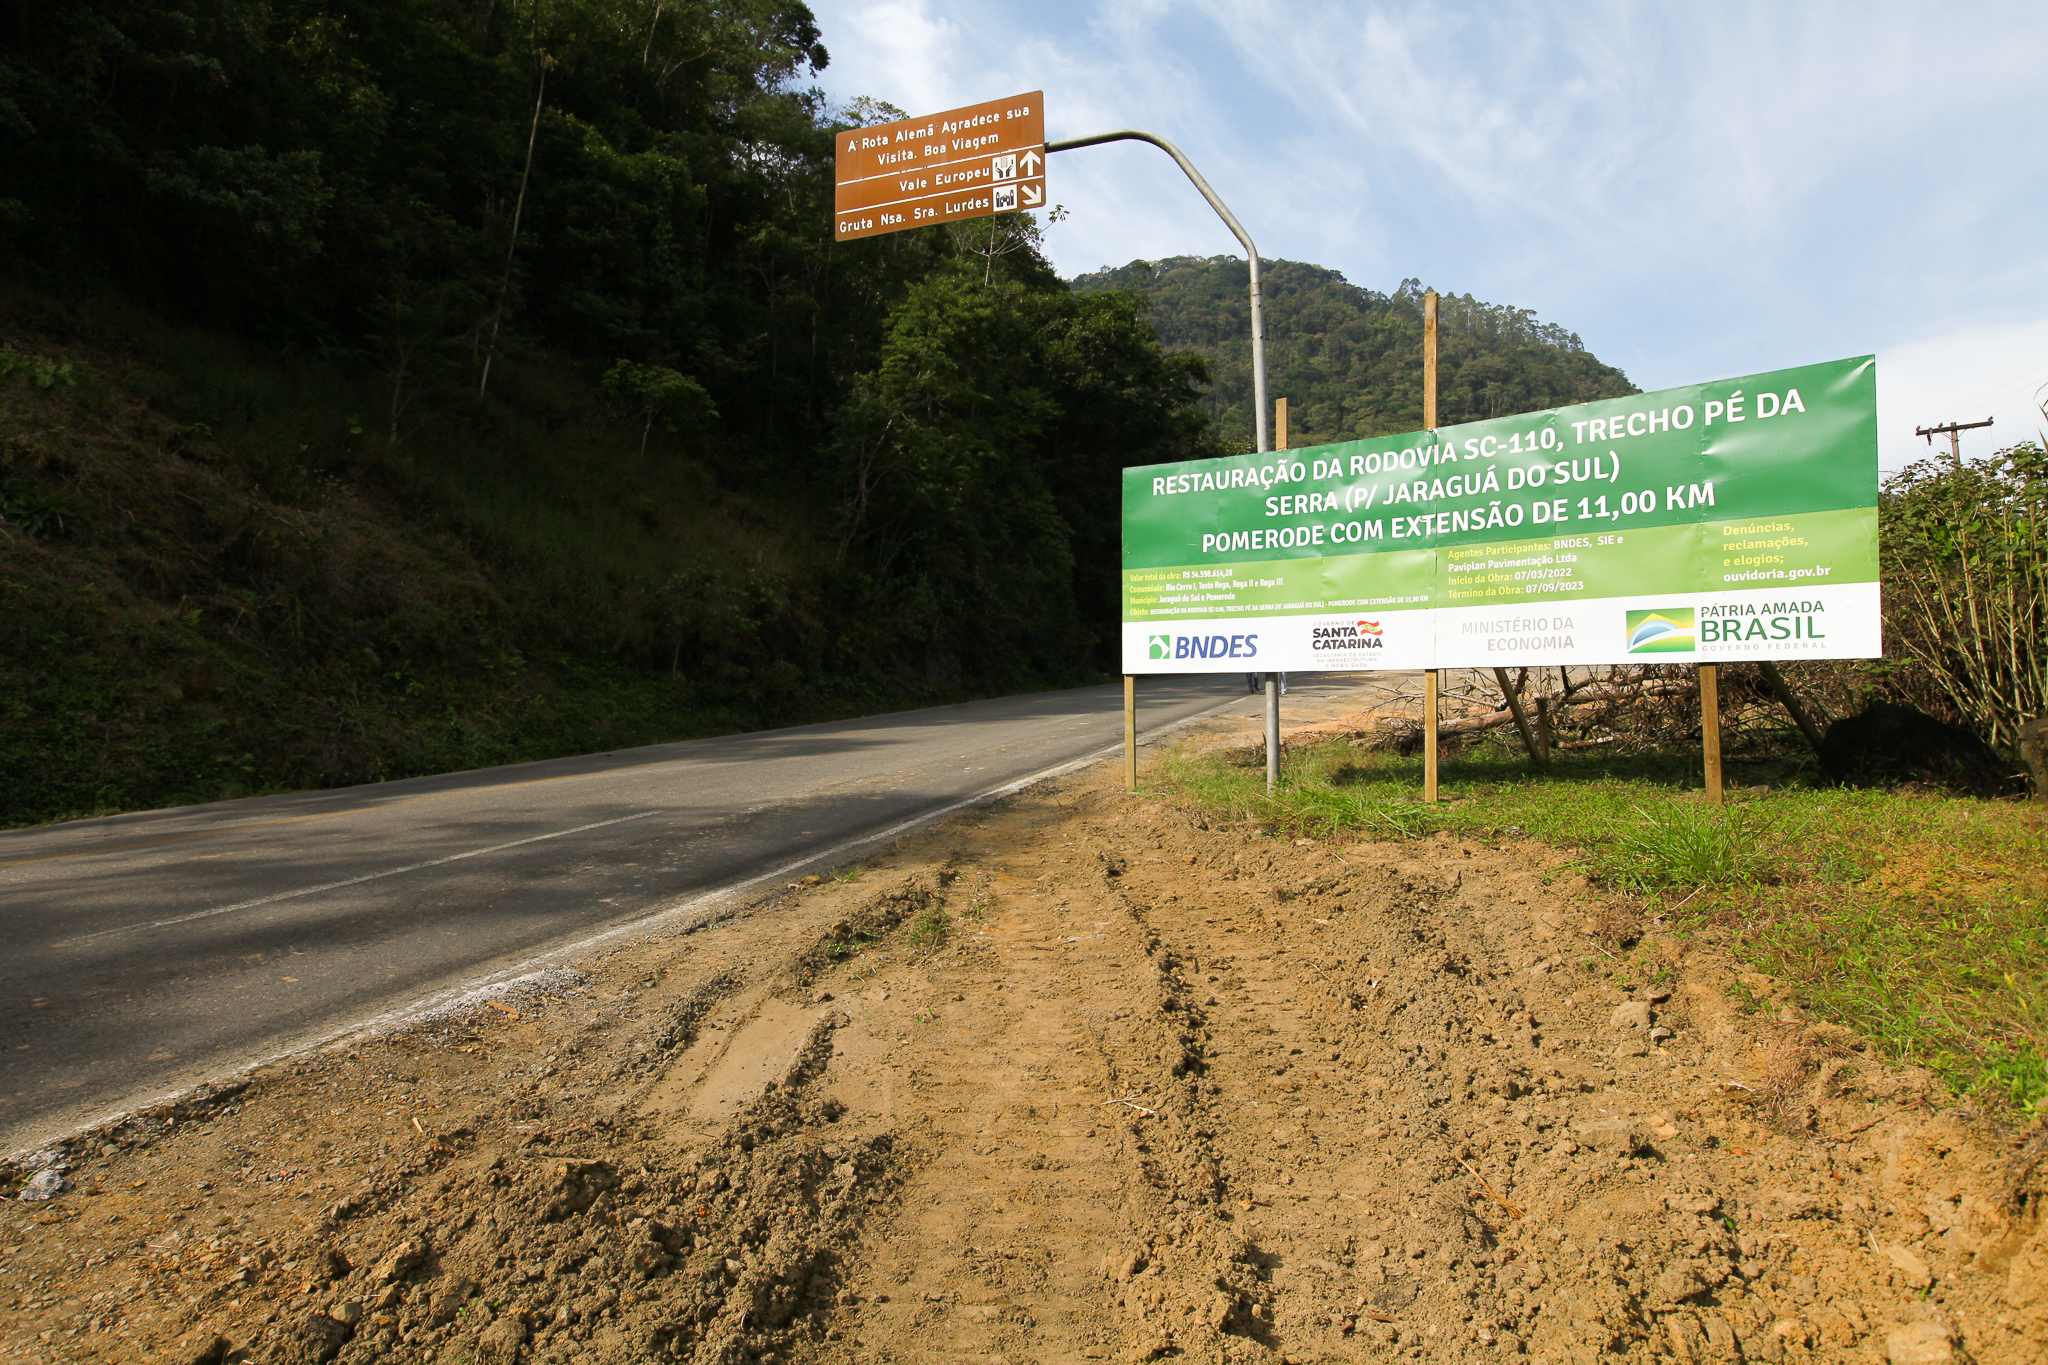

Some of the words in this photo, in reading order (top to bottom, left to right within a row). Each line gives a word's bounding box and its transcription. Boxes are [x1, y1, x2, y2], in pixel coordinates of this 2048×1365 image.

[848, 141, 856, 152] A
[862, 135, 888, 149] Rota
[896, 124, 934, 142] Alemã
[942, 112, 1000, 134] Agradece
[1007, 106, 1029, 120] sua
[878, 152, 917, 165] Visita.
[924, 143, 946, 156] Boa
[952, 134, 998, 151] Viagem
[900, 179, 926, 192] Vale
[936, 167, 990, 185] Europeu
[840, 218, 872, 233] Gruta
[881, 212, 906, 226] Nsa.
[914, 208, 938, 220] Sra.
[946, 198, 989, 214] Lurdes
[1153, 459, 1306, 495] RESTAURAÇÃO
[1313, 458, 1343, 480] DA
[1350, 442, 1458, 475] RODOVIA
[1464, 428, 1564, 460] SC-110,
[1572, 405, 1694, 444] TRECHO
[1704, 390, 1746, 426] PÉ
[1757, 388, 1806, 418] DA
[1266, 491, 1338, 516] SERRA
[1345, 485, 1377, 512] (P/
[1383, 464, 1499, 505] JARAGUÁ
[1508, 465, 1546, 490] DO
[1554, 450, 1620, 484] SUL)
[1202, 525, 1324, 552] POMERODE
[1330, 520, 1384, 543] COM
[1392, 501, 1524, 538] EXTENSÃO
[1532, 499, 1568, 524] DE
[1577, 490, 1656, 522] 11,00
[1666, 482, 1715, 510] KM
[1723, 521, 1794, 536] Denúncias,
[1448, 548, 1483, 559] Agentes
[1486, 543, 1551, 556] Participantes:
[1554, 538, 1592, 549] BNDES,
[1598, 535, 1614, 546] SIE
[1723, 536, 1808, 551] reclamações,
[1448, 561, 1486, 573] Paviplan
[1488, 555, 1553, 569] Pavimentação
[1556, 553, 1577, 563] Ltda
[1723, 557, 1730, 566] e
[1734, 554, 1784, 566] elogios;
[1448, 576, 1472, 585] Início
[1475, 574, 1485, 583] da
[1488, 572, 1512, 582] Obra:
[1515, 568, 1572, 580] 07/03/2022
[1723, 565, 1831, 582] ouvidoria.gov.br
[1130, 584, 1164, 593] Comunidade:
[1215, 581, 1231, 590] Rega,
[1233, 580, 1247, 589] Rega
[1260, 579, 1275, 588] Rega
[1448, 588, 1483, 598] Término
[1486, 586, 1496, 596] da
[1498, 585, 1523, 595] Obra:
[1526, 581, 1584, 593] 07/09/2023
[1130, 596, 1158, 605] Município:
[1159, 594, 1181, 604] Jaraguá
[1206, 592, 1235, 601] Pomerode
[1130, 608, 1149, 617] Objeto:
[1701, 603, 1756, 618] PÁTRIA
[1761, 601, 1824, 614] AMADA
[1313, 627, 1358, 638] SANTA
[1462, 617, 1547, 634] MINISTÉRIO
[1554, 617, 1574, 630] DA
[1701, 616, 1826, 642] BRASIL
[1175, 634, 1258, 659] BNDES
[1312, 638, 1382, 650] CATARINA
[1488, 636, 1574, 651] ECONOMIA
